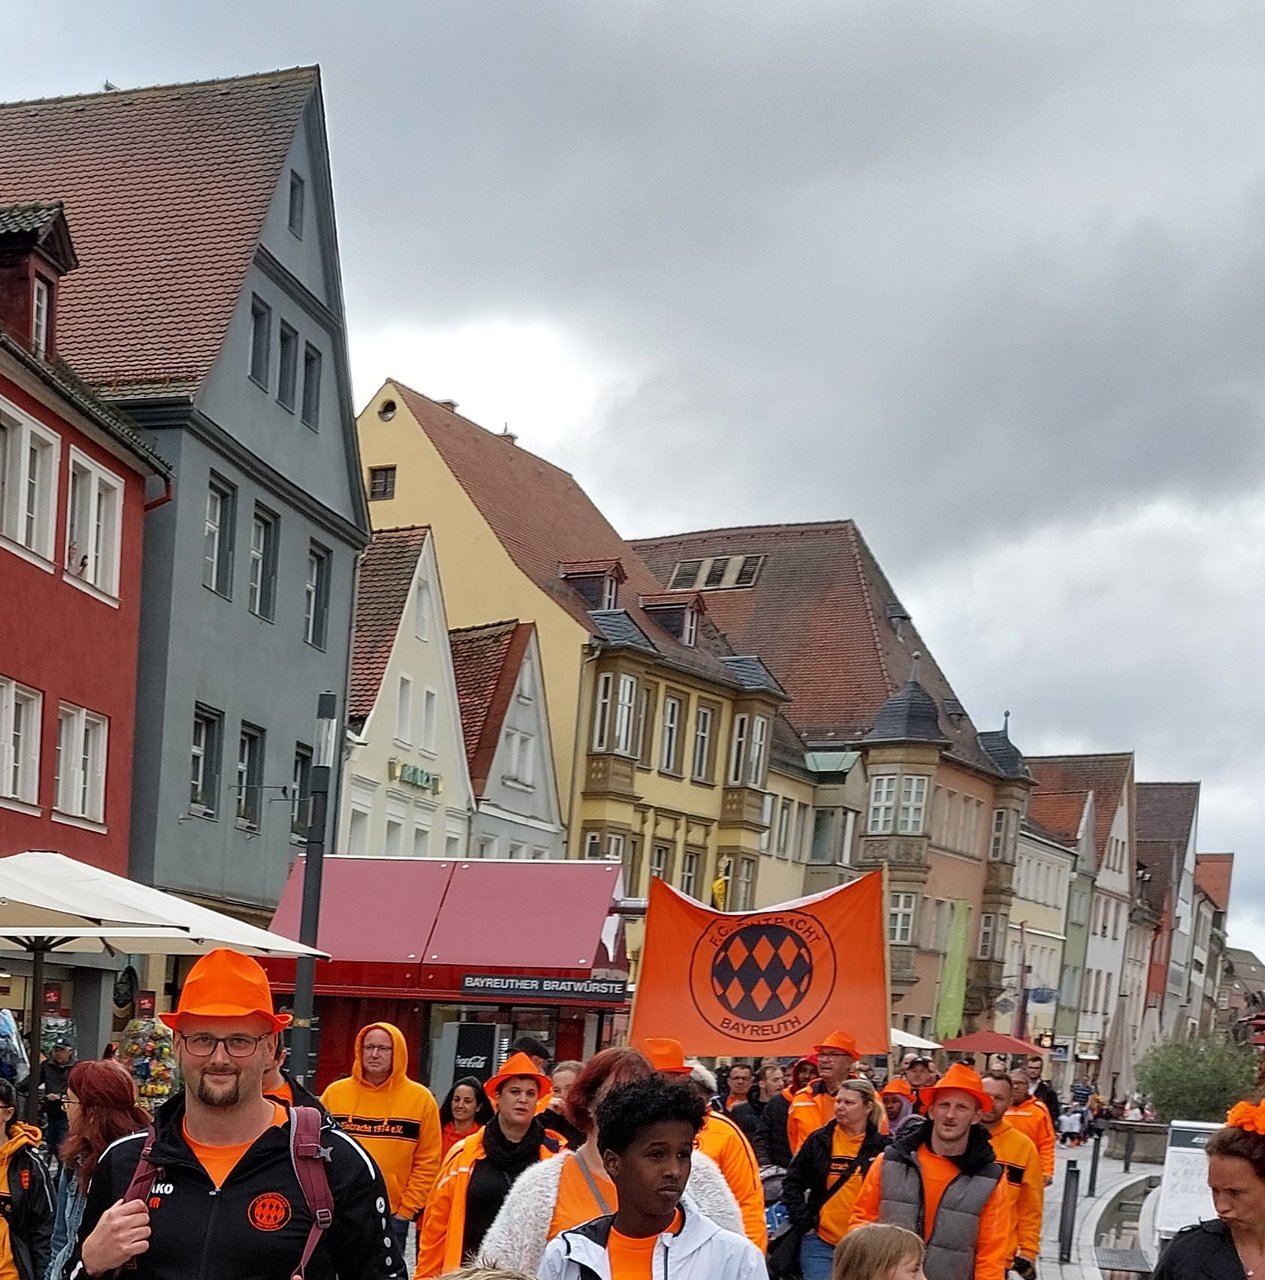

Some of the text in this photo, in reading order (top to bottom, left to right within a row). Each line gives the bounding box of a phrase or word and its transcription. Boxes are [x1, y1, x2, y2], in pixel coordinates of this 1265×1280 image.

[464, 976, 624, 995] BAYREUTHER BRATWÜRSTE
[720, 1016, 802, 1037] BAYREUTH
[151, 1183, 174, 1195] KO
